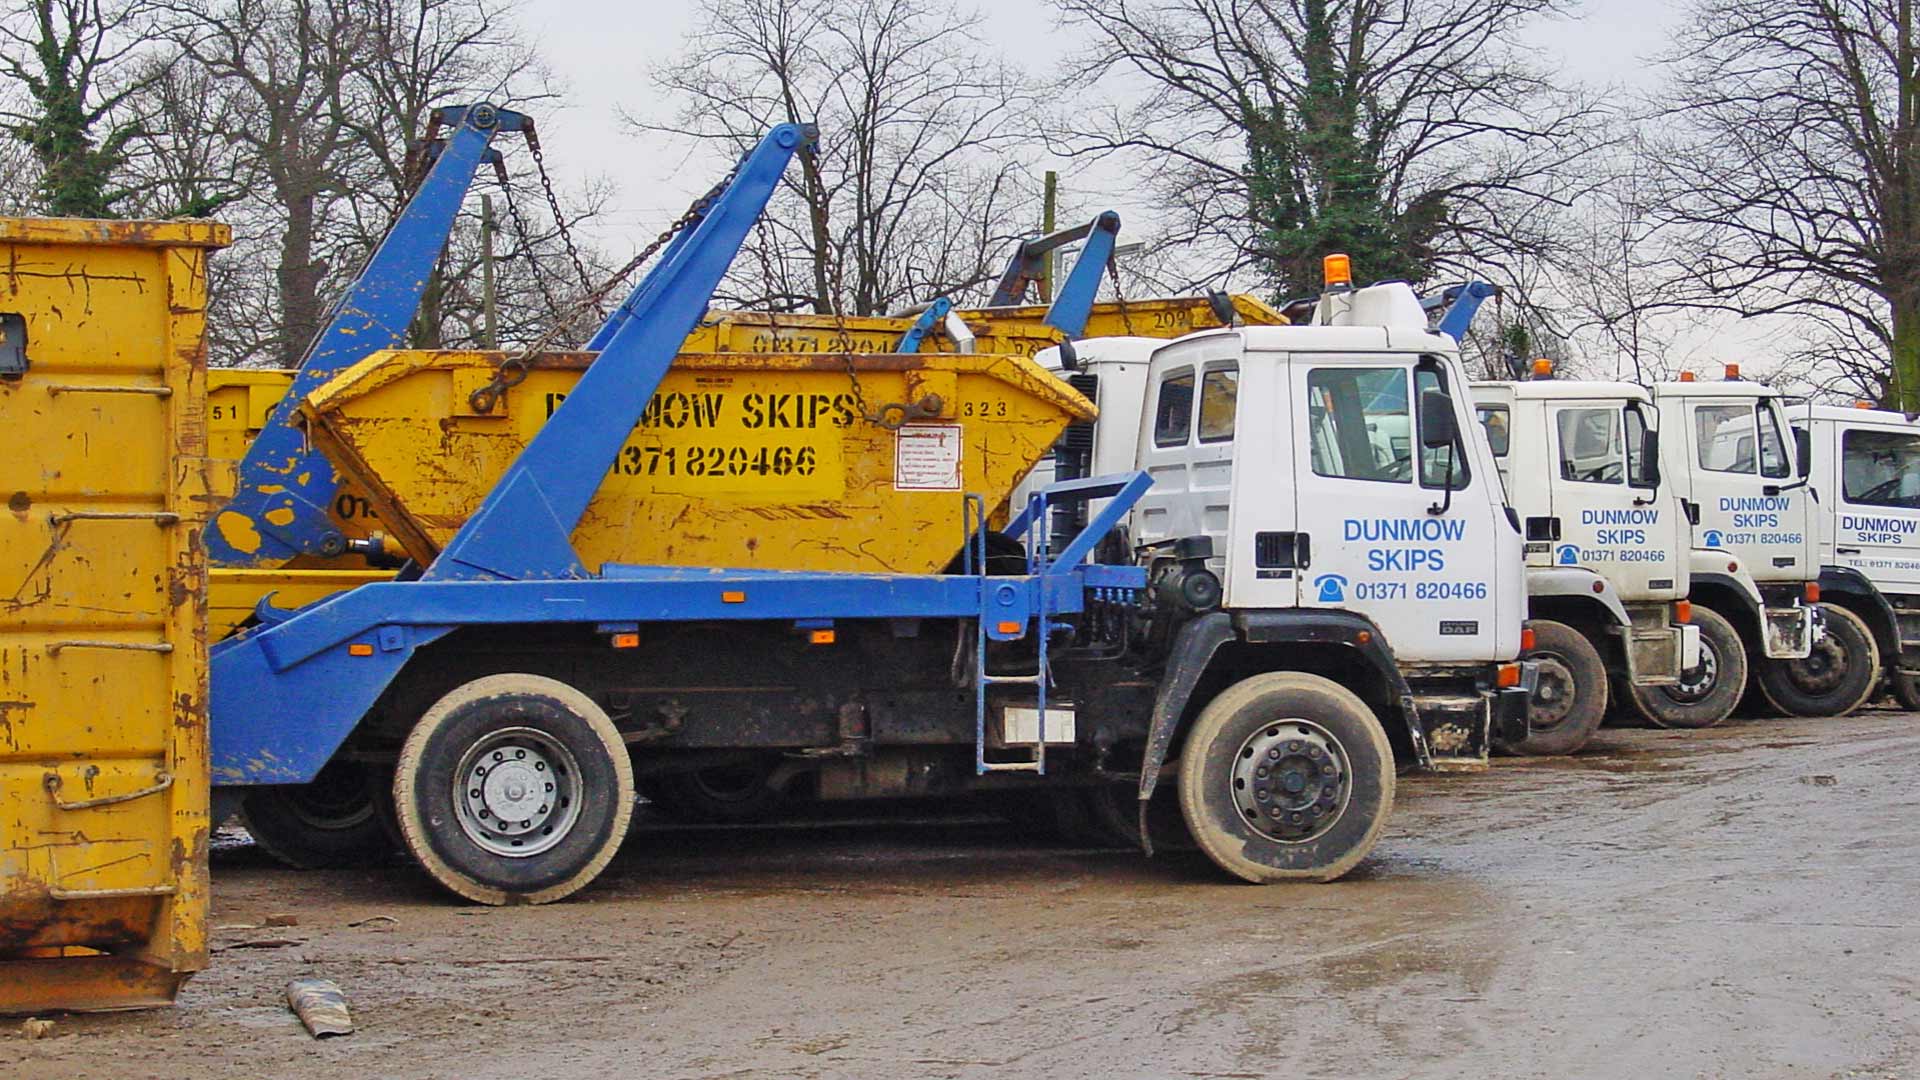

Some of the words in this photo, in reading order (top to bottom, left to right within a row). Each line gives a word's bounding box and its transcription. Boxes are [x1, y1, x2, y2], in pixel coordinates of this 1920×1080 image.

[546, 392, 723, 430] DMOW
[741, 393, 855, 429] SKIPS
[613, 446, 677, 476] 1371
[685, 446, 816, 476] 820466
[1719, 497, 1790, 511] DUNMOW
[1581, 509, 1659, 525] DUNMOW
[1733, 513, 1779, 528] SKIPS
[1842, 515, 1918, 534] DUNMOW
[1343, 518, 1466, 542] DUNMOW
[1596, 529, 1646, 545] SKIPS
[1857, 531, 1902, 544] SKIPS
[1726, 533, 1757, 544] 01371
[1760, 533, 1802, 544] 820466
[1367, 548, 1445, 572] SKIPS
[1581, 550, 1616, 562] 01371
[1619, 550, 1665, 562] 820466
[1355, 582, 1407, 600] 01371
[1415, 582, 1487, 600] 820466
